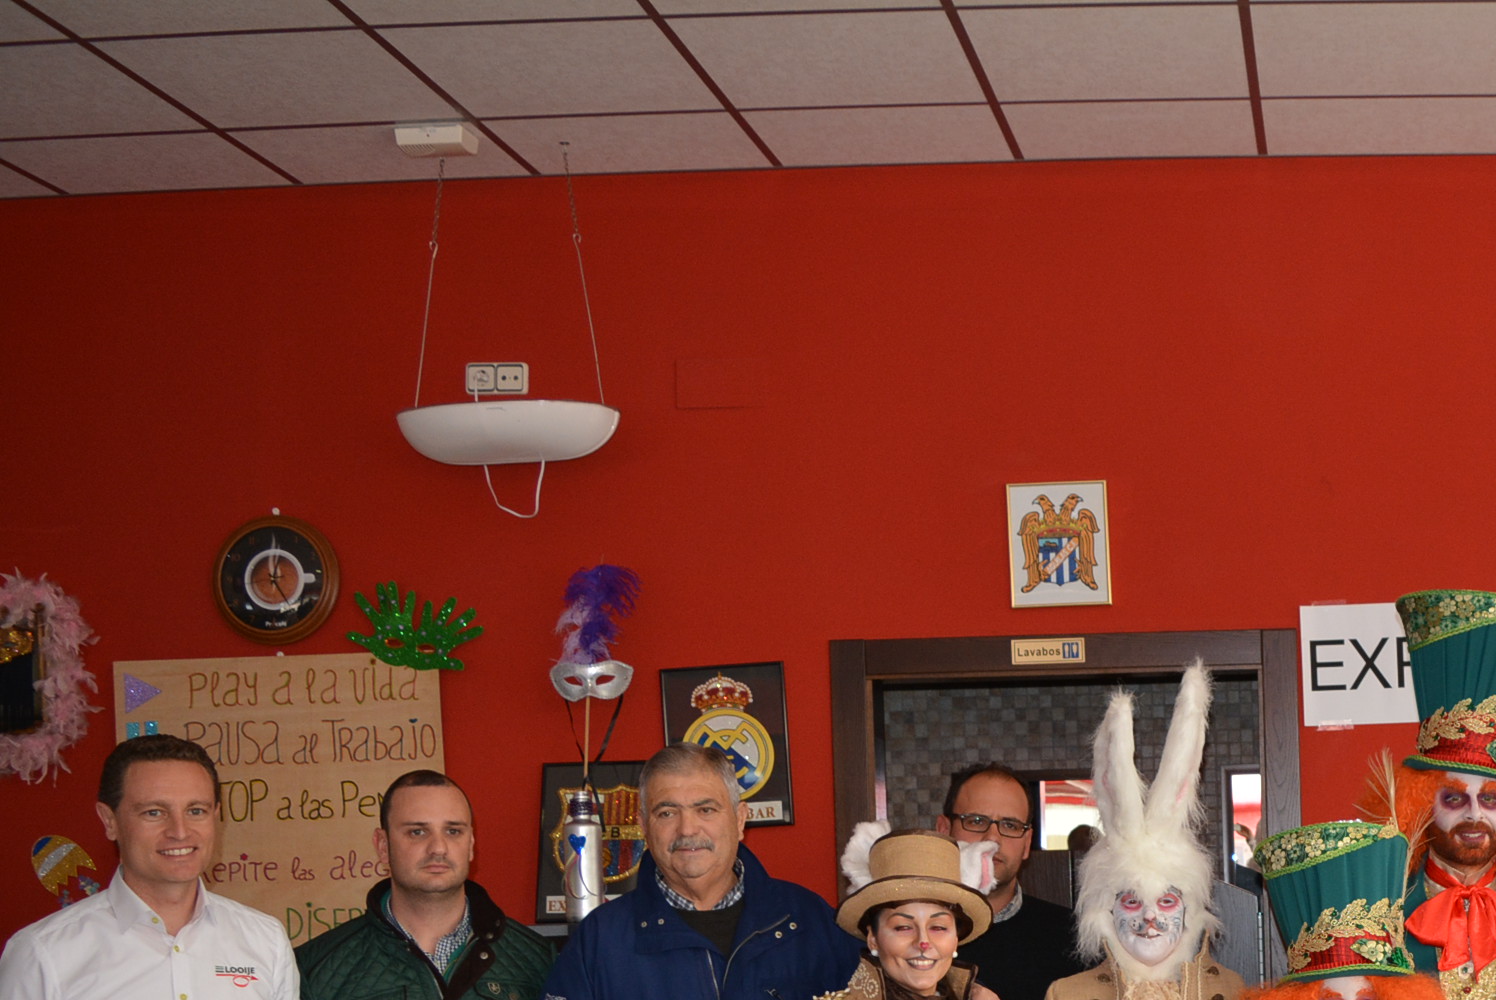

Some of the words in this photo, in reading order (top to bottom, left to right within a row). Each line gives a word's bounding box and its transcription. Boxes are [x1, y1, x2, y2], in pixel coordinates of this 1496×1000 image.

[1017, 646, 1061, 658] Lavabos
[271, 671, 294, 706] a
[305, 667, 340, 704] la
[219, 778, 269, 823] TOP
[276, 797, 294, 821] a
[299, 789, 335, 820] las
[291, 855, 315, 881] las
